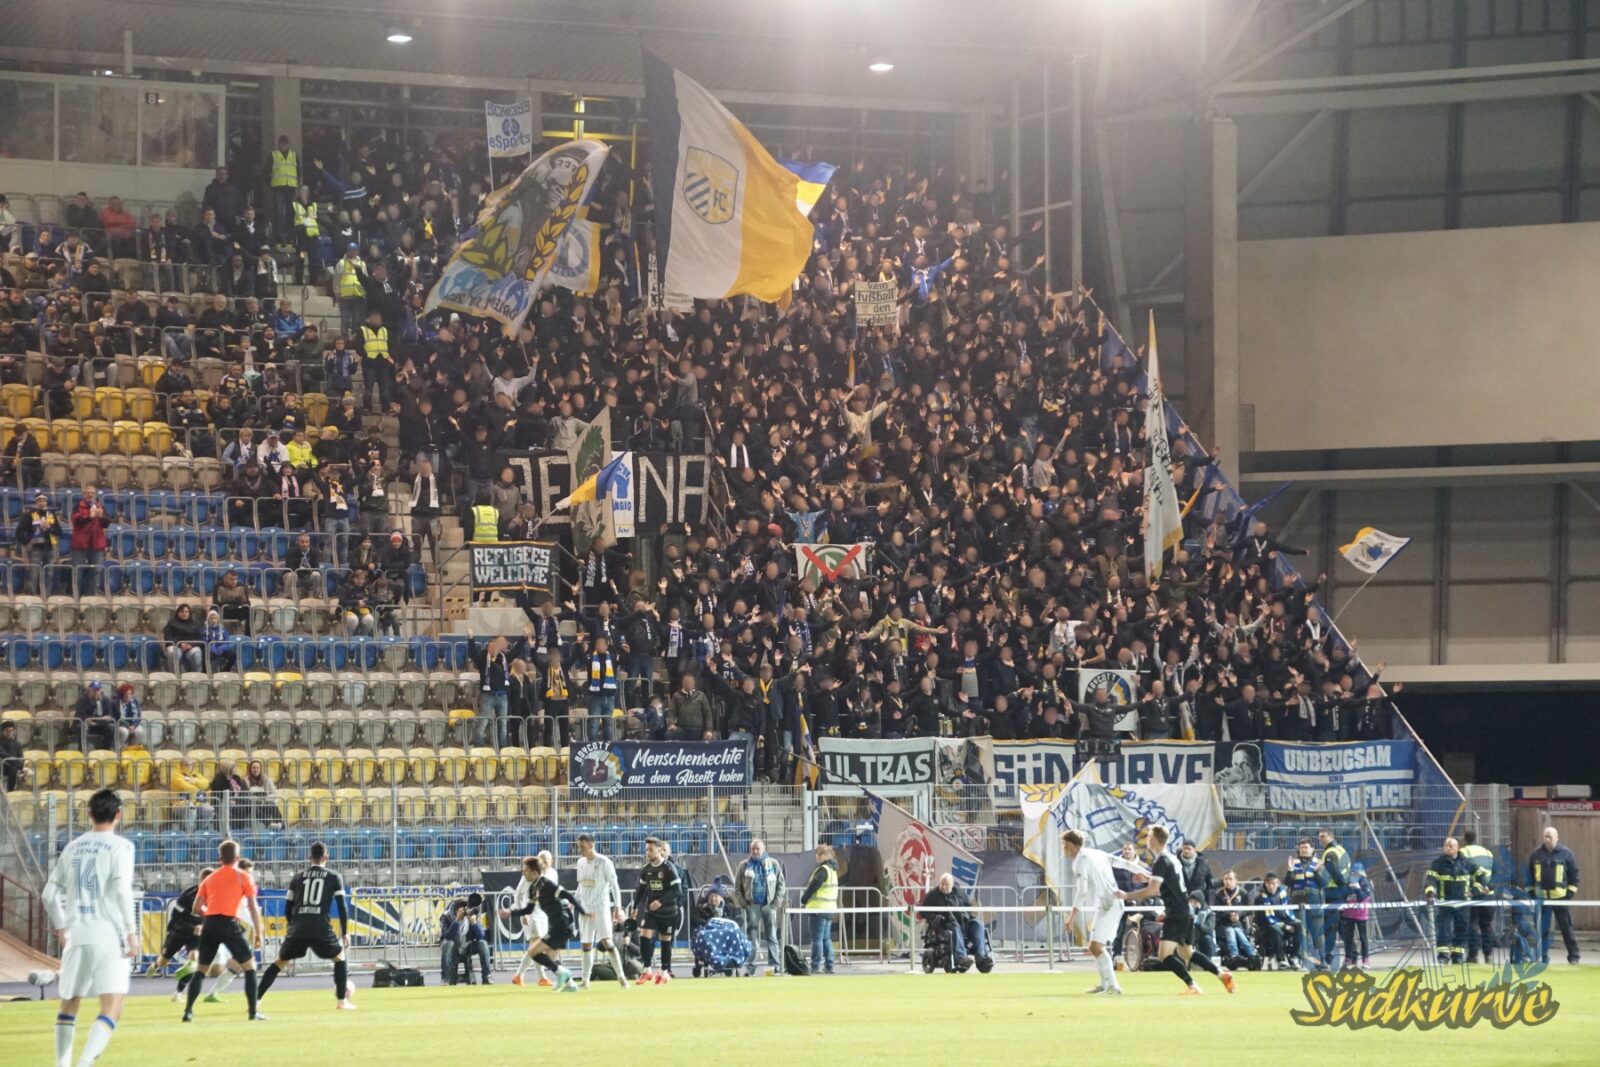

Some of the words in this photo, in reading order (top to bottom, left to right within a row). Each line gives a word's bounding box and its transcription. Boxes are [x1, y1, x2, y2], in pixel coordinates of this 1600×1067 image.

[857, 288, 894, 302] fußball
[872, 303, 891, 314] den
[474, 546, 551, 566] REFUGEES
[474, 564, 550, 585] WELCOME
[574, 741, 611, 763] BOYCOTT
[631, 747, 745, 769] Menschenrechte
[1284, 745, 1392, 772] UNBEUGSAM
[627, 772, 646, 784] aus
[650, 770, 671, 784] dem
[675, 769, 717, 787] Abseits
[718, 768, 744, 783] holen
[824, 752, 932, 785] ULTRAS
[1327, 775, 1345, 783] UND
[574, 775, 599, 797] QATAR
[1269, 783, 1412, 810] UNVERKÄUFLICH
[71, 858, 98, 900] 14
[302, 870, 328, 878] BERLIN
[302, 878, 325, 906] 10
